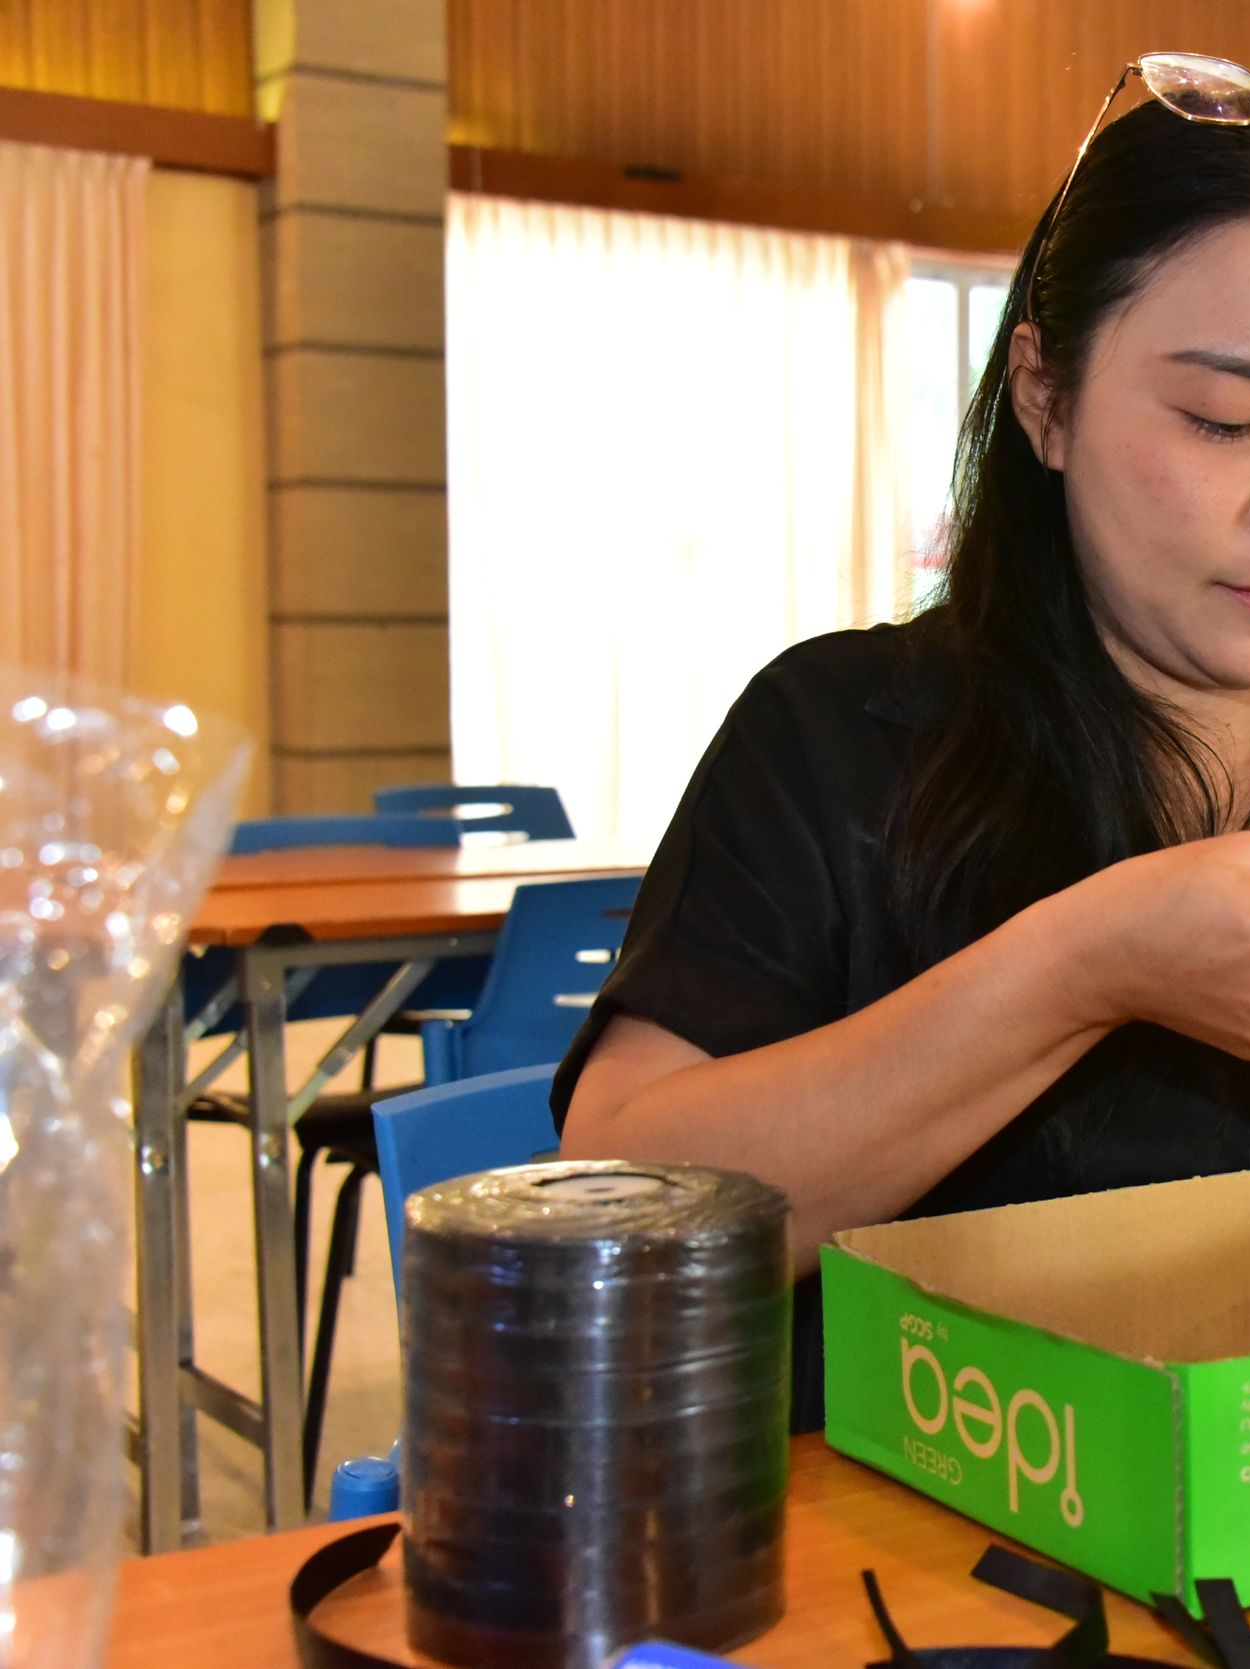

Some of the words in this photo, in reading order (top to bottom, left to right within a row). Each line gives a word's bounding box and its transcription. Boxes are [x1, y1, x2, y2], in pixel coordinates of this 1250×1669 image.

[900, 1313, 934, 1341] SCGP
[900, 1337, 1084, 1528] idea
[904, 1436, 962, 1486] GREEN
